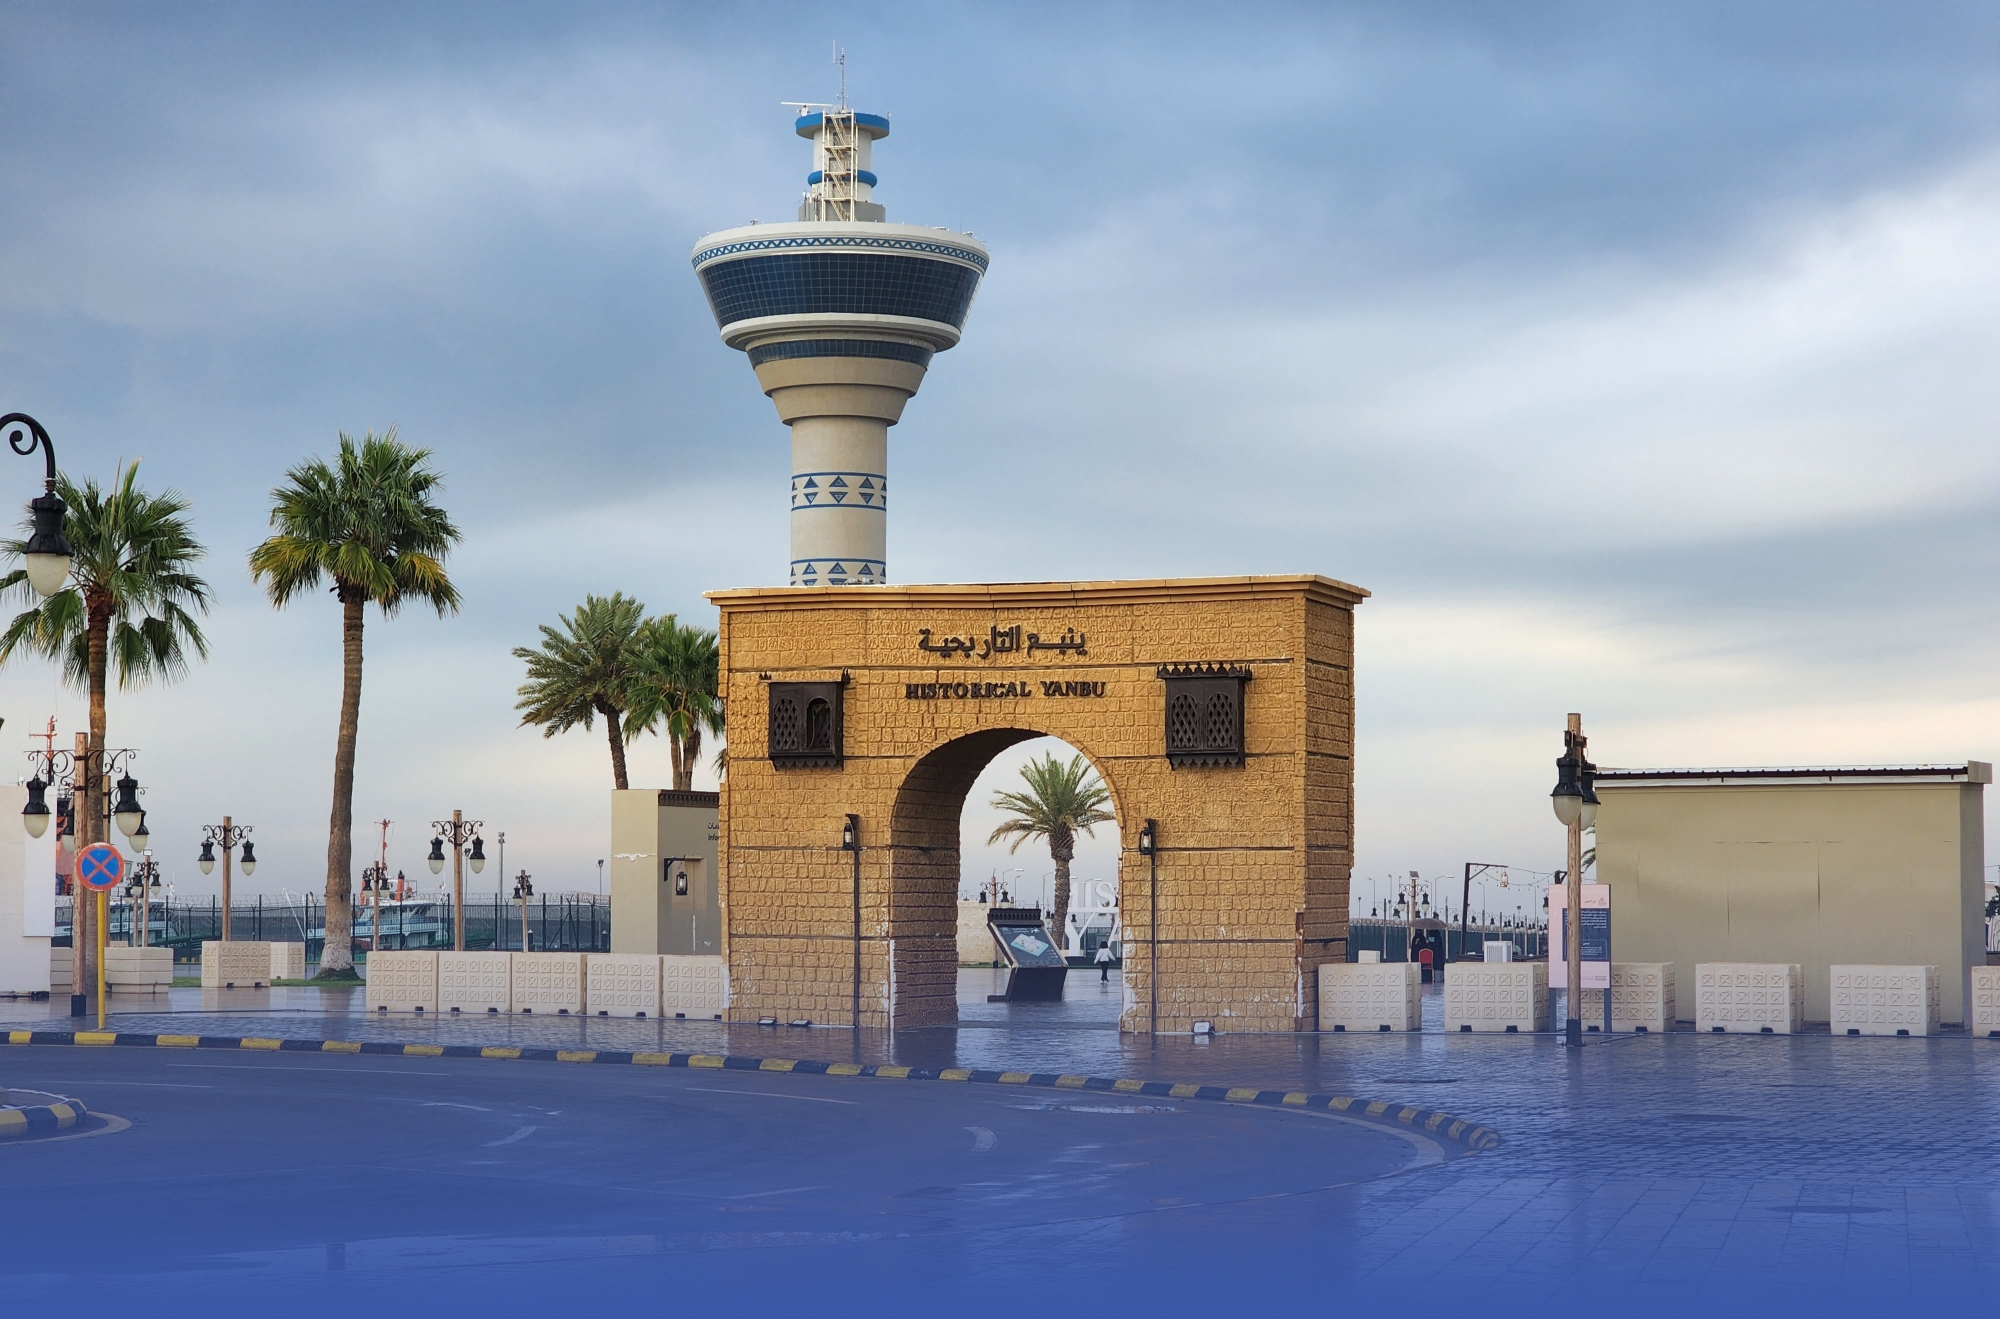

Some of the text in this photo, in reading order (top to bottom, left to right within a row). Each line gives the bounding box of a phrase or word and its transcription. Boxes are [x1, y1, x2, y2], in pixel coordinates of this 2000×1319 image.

[1026, 626, 1088, 658] ينبع
[905, 680, 1106, 699] HISTORICAL YANBU
